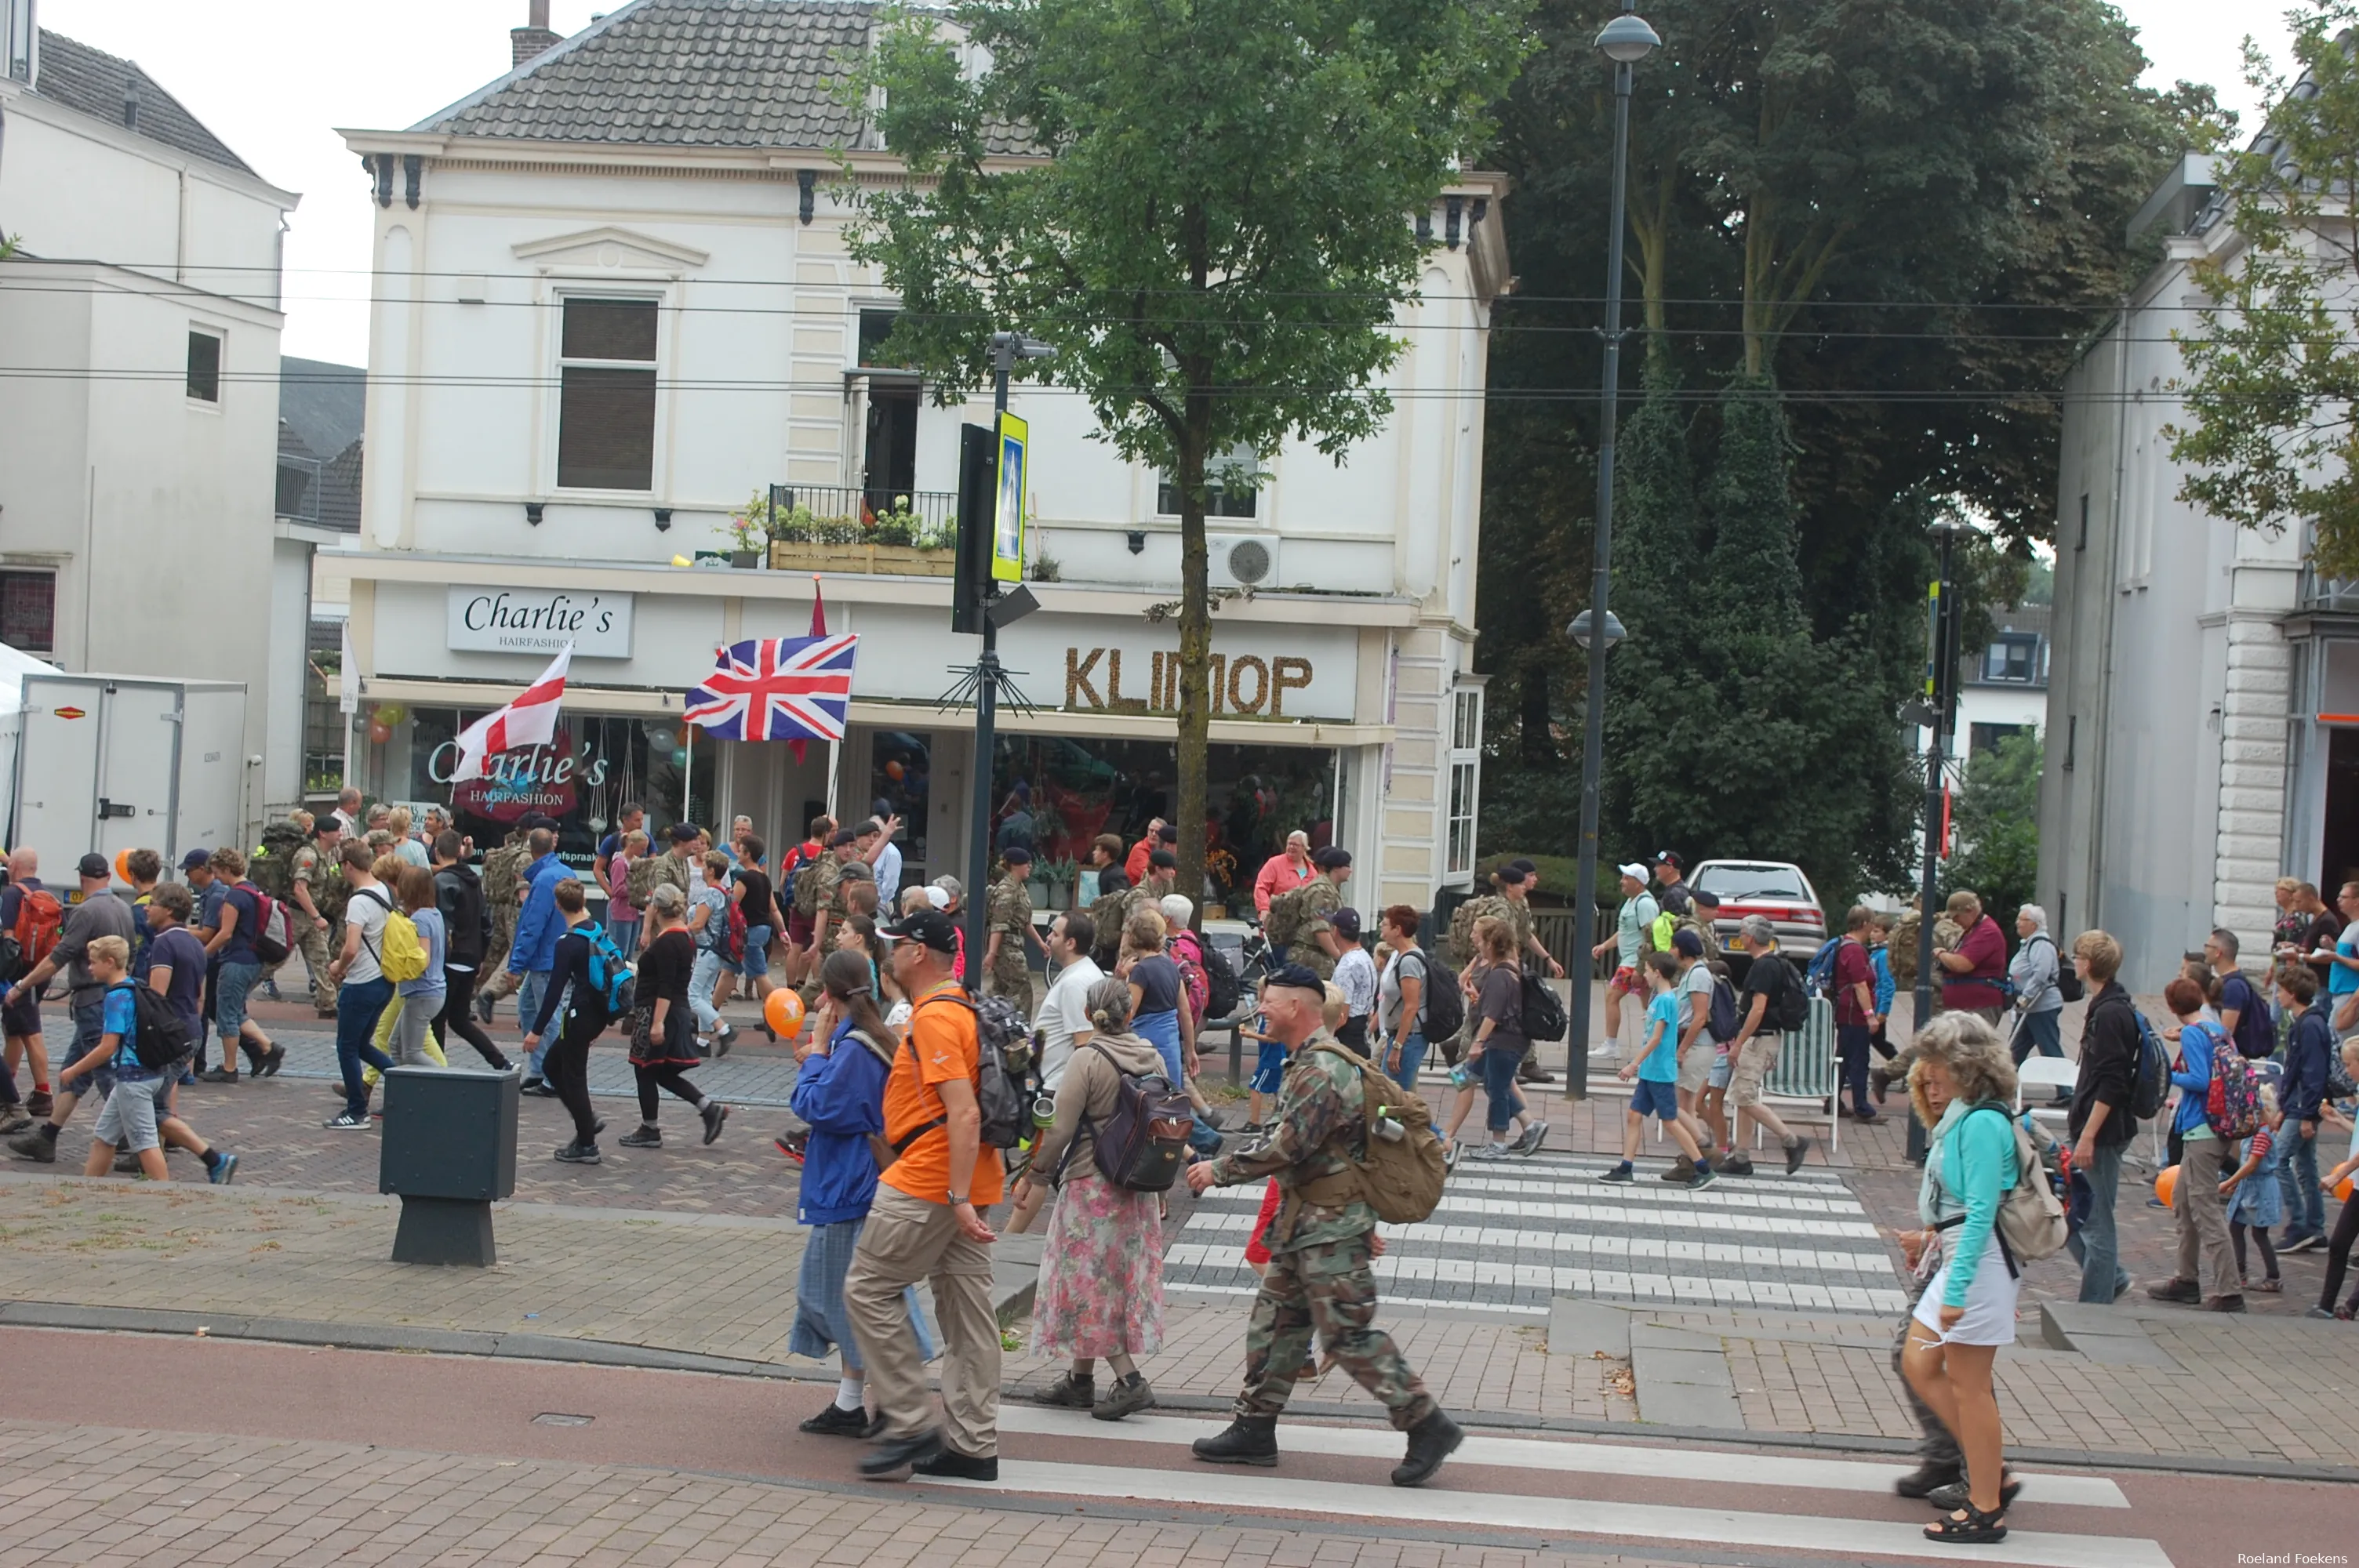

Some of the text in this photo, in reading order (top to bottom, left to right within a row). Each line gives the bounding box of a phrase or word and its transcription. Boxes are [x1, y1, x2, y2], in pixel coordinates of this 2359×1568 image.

[465, 593, 613, 633] Charlie's
[428, 740, 609, 786] Carlie's
[470, 790, 564, 805] HAIRFASHION
